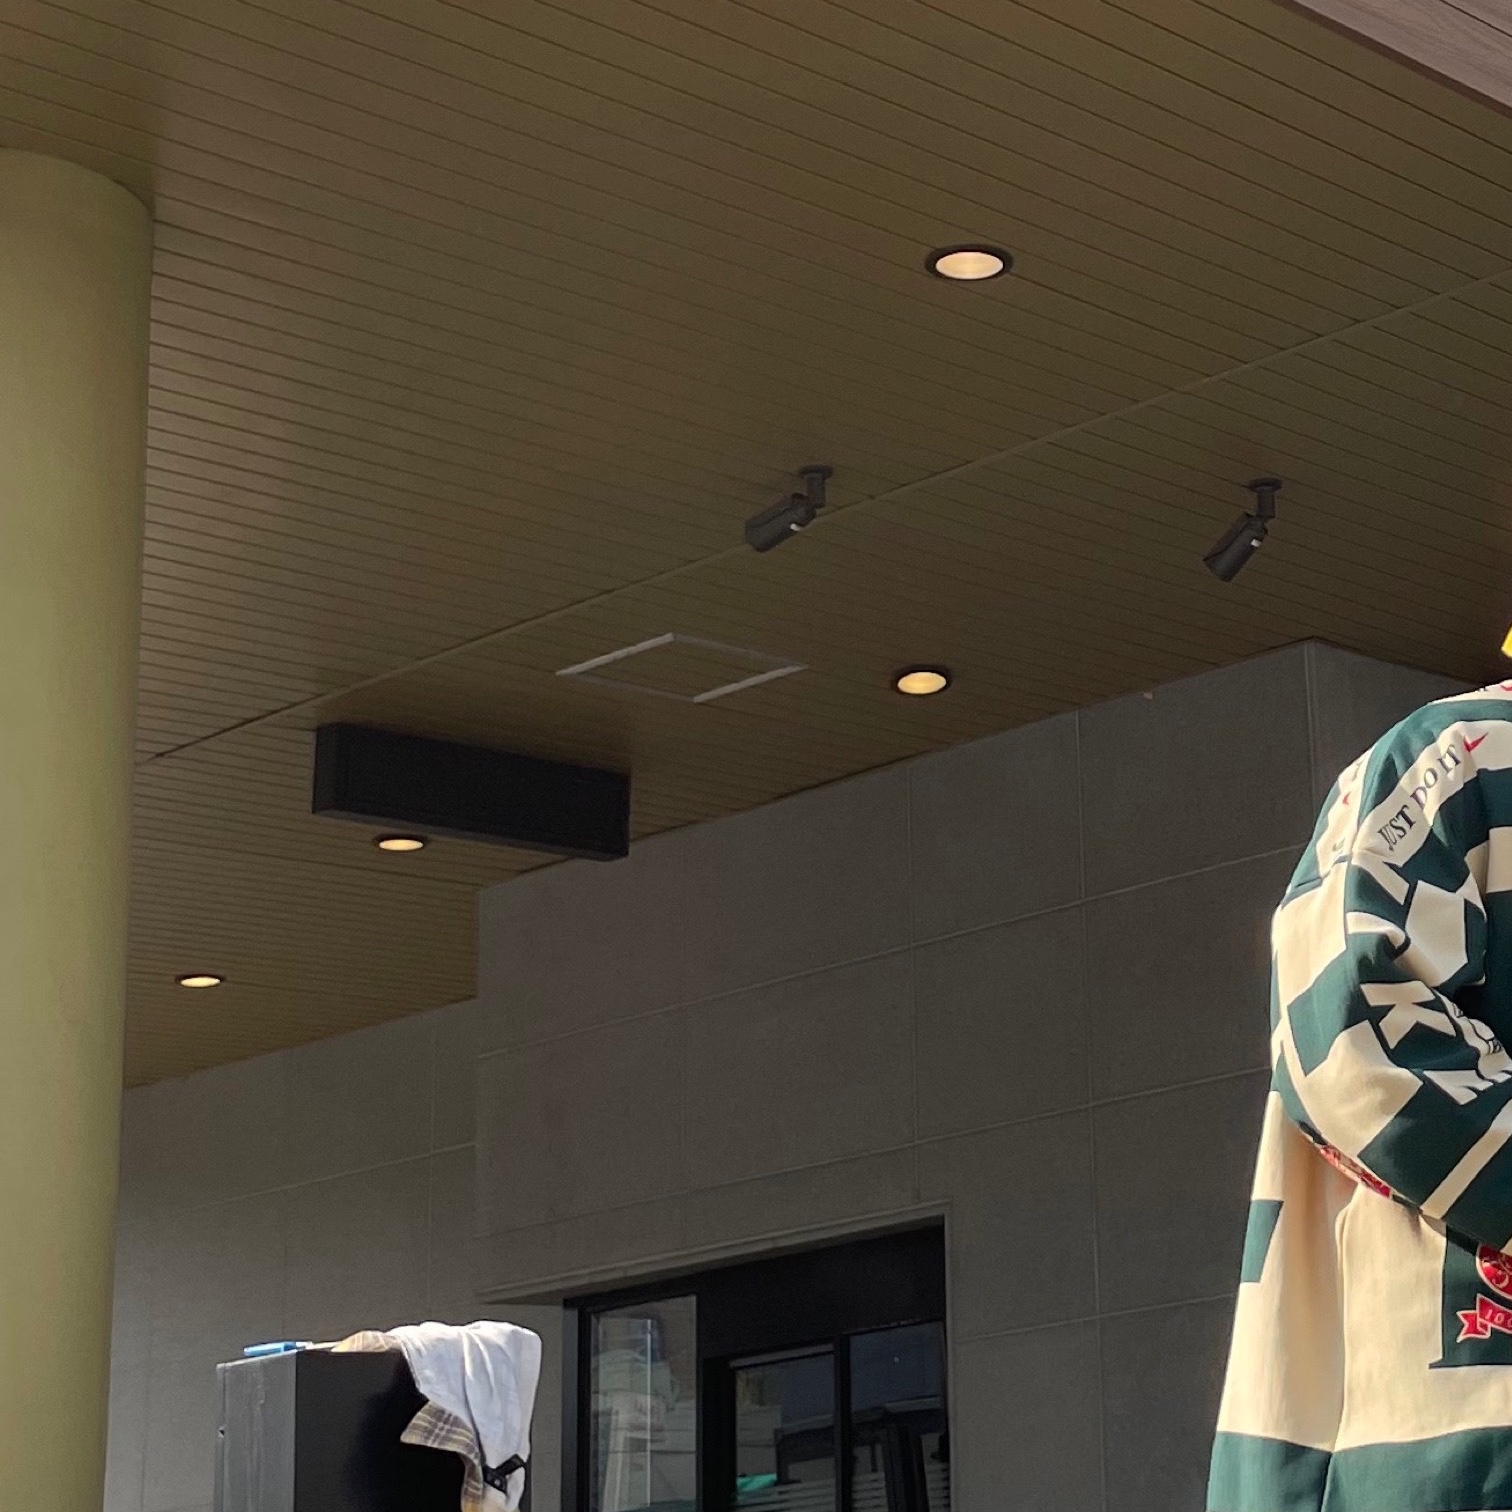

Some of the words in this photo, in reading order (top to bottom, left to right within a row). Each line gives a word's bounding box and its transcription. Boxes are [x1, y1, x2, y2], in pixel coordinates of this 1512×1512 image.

[1378, 804, 1416, 851] JUST
[1411, 768, 1438, 811] DO
[1437, 744, 1463, 774] IT
